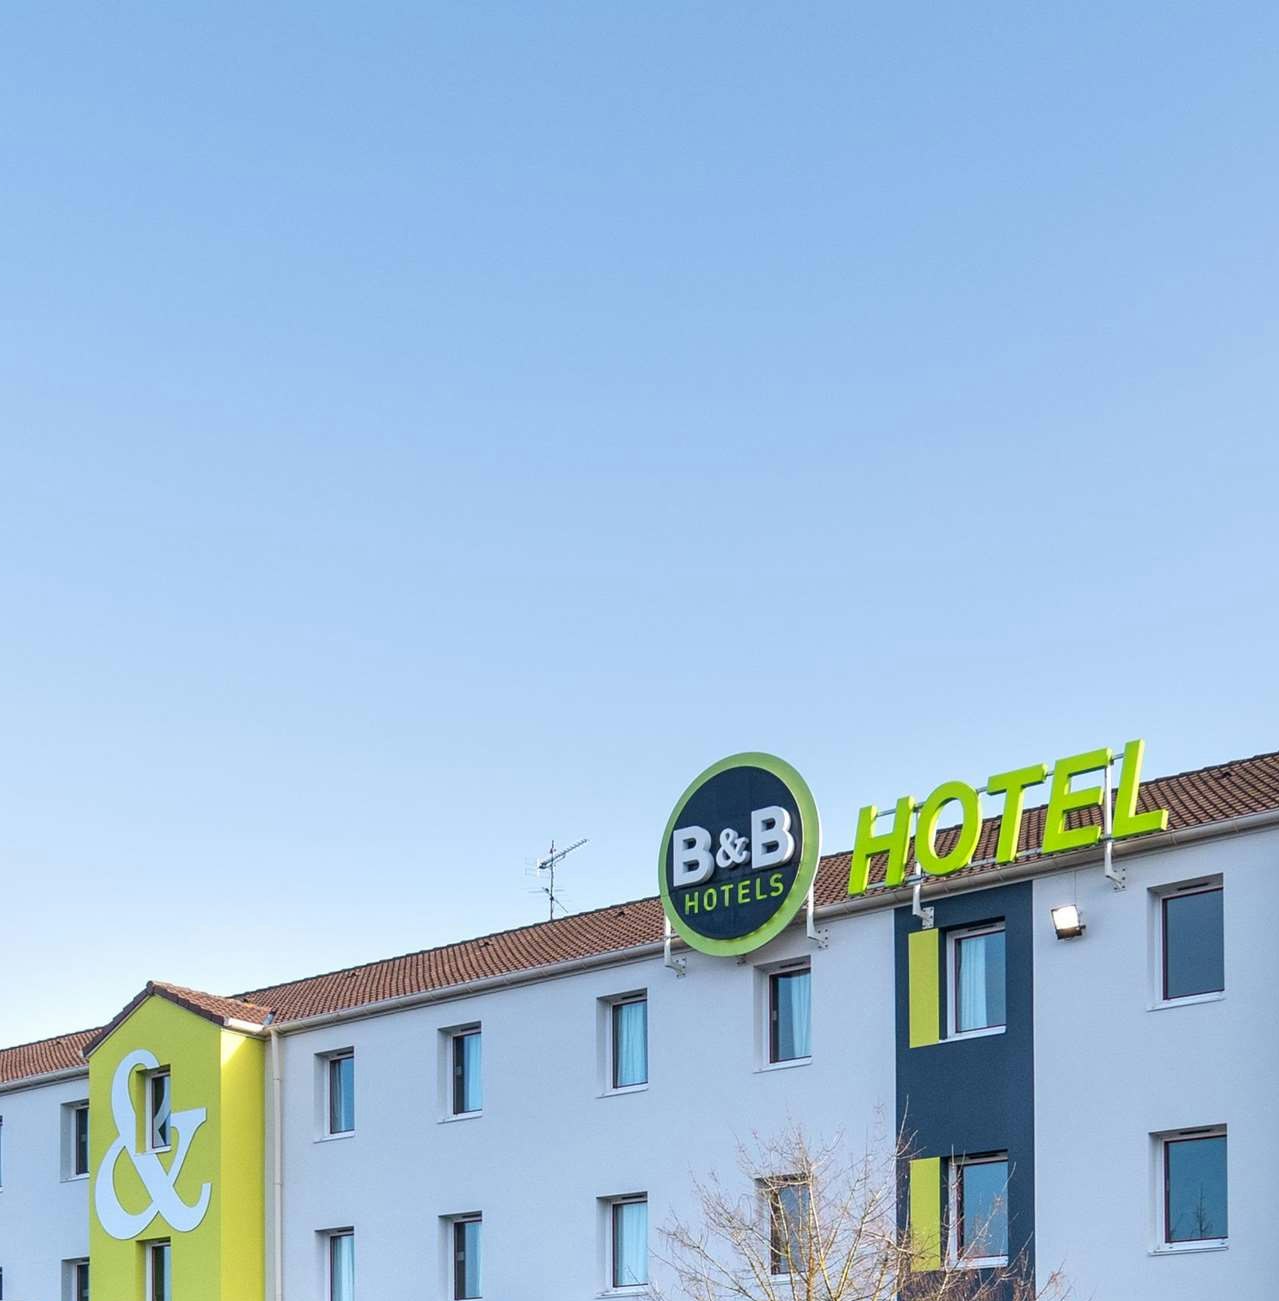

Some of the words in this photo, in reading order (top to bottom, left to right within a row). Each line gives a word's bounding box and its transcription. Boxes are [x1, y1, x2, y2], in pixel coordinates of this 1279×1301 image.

[673, 805, 795, 888] B&B
[848, 738, 1169, 896] HOTEL
[685, 873, 784, 915] HOTELS
[95, 1049, 212, 1240] &
